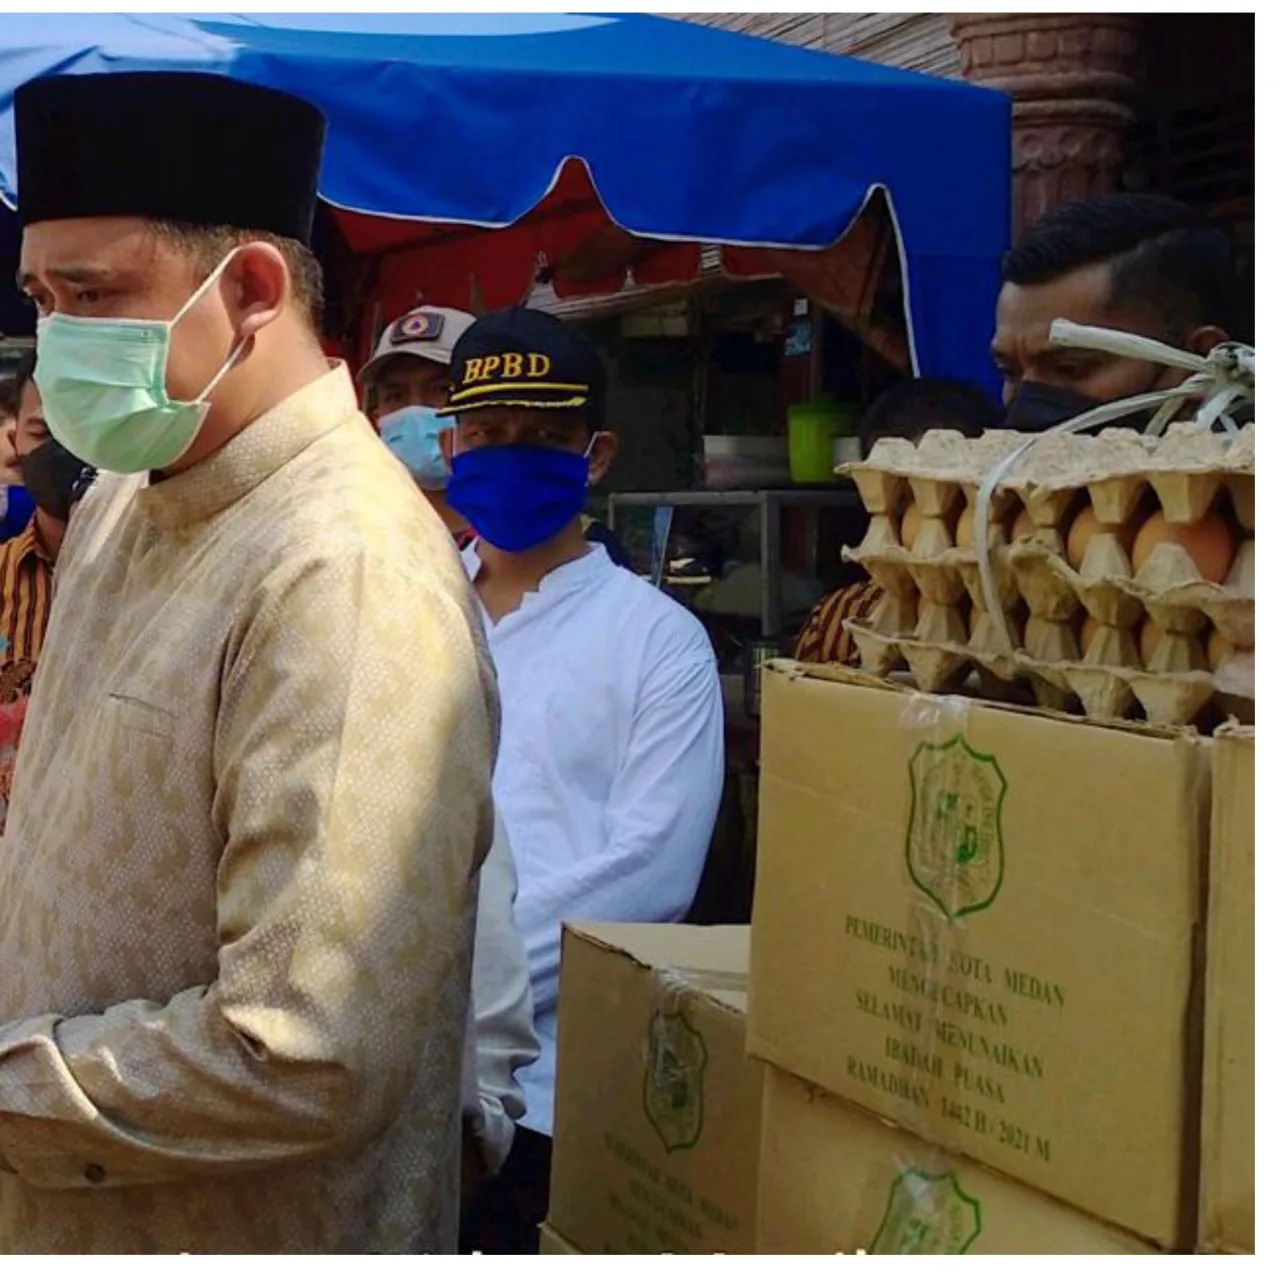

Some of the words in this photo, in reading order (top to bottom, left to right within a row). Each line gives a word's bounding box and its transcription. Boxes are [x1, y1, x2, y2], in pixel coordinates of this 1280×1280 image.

[462, 352, 550, 385] BPBD
[888, 965, 1008, 1026] MENGCAPKAN
[1004, 966, 1067, 1007] MEDAN
[846, 1055, 929, 1108] RAMADHAN
[953, 1061, 1005, 1104] PUASA
